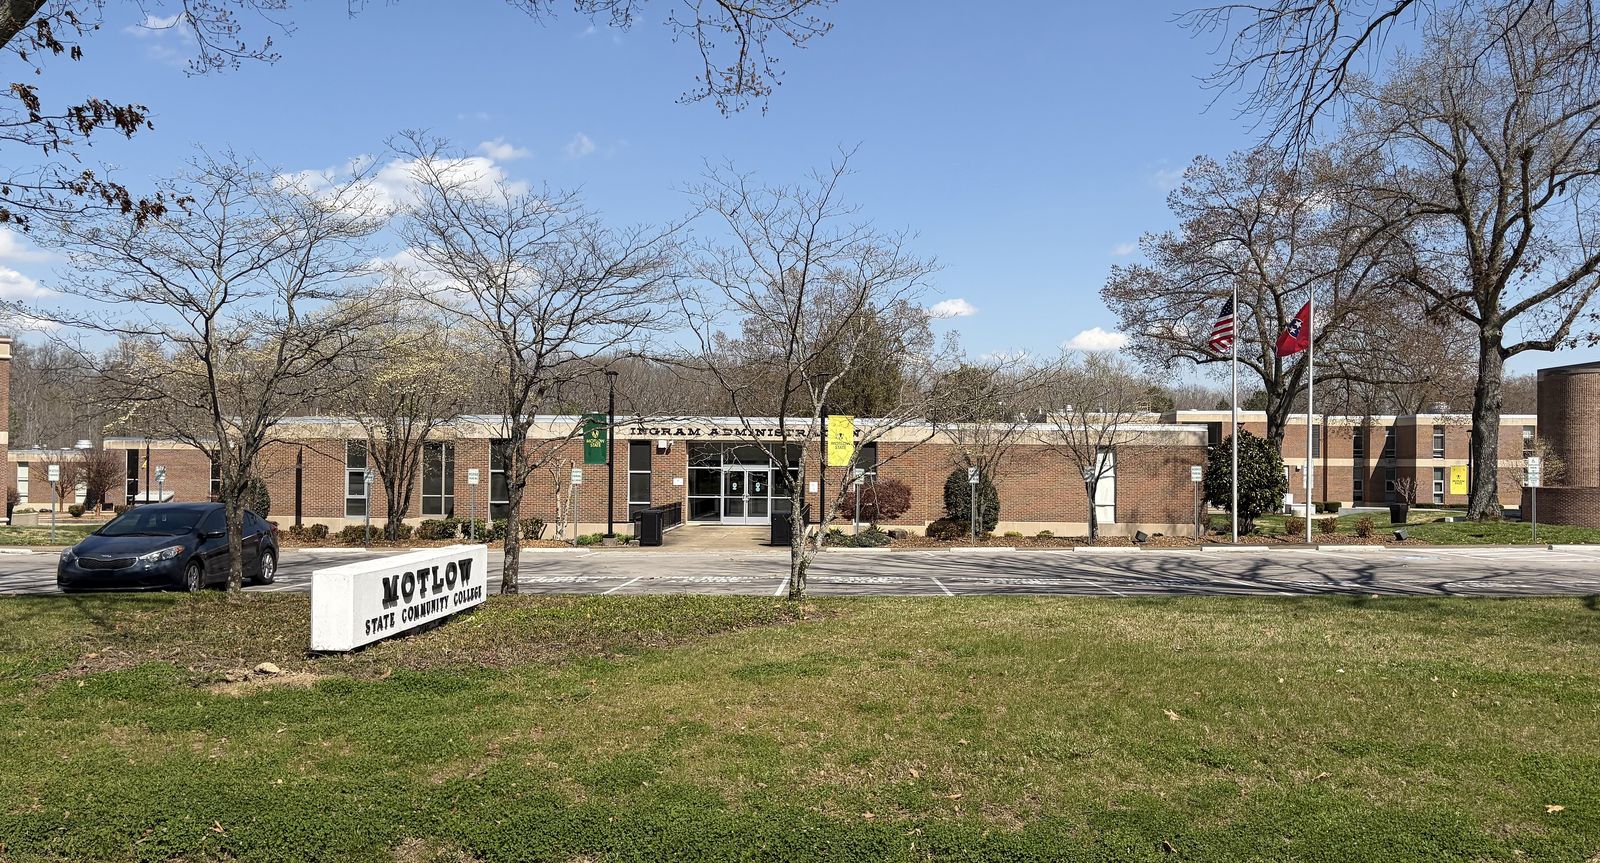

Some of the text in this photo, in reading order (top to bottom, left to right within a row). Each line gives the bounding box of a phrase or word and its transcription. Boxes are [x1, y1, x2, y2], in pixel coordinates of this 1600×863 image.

[629, 427, 702, 436] INGRAM
[382, 558, 473, 607] MOTLOW
[365, 585, 482, 636] STATE COMMUNITY COLLEGE
